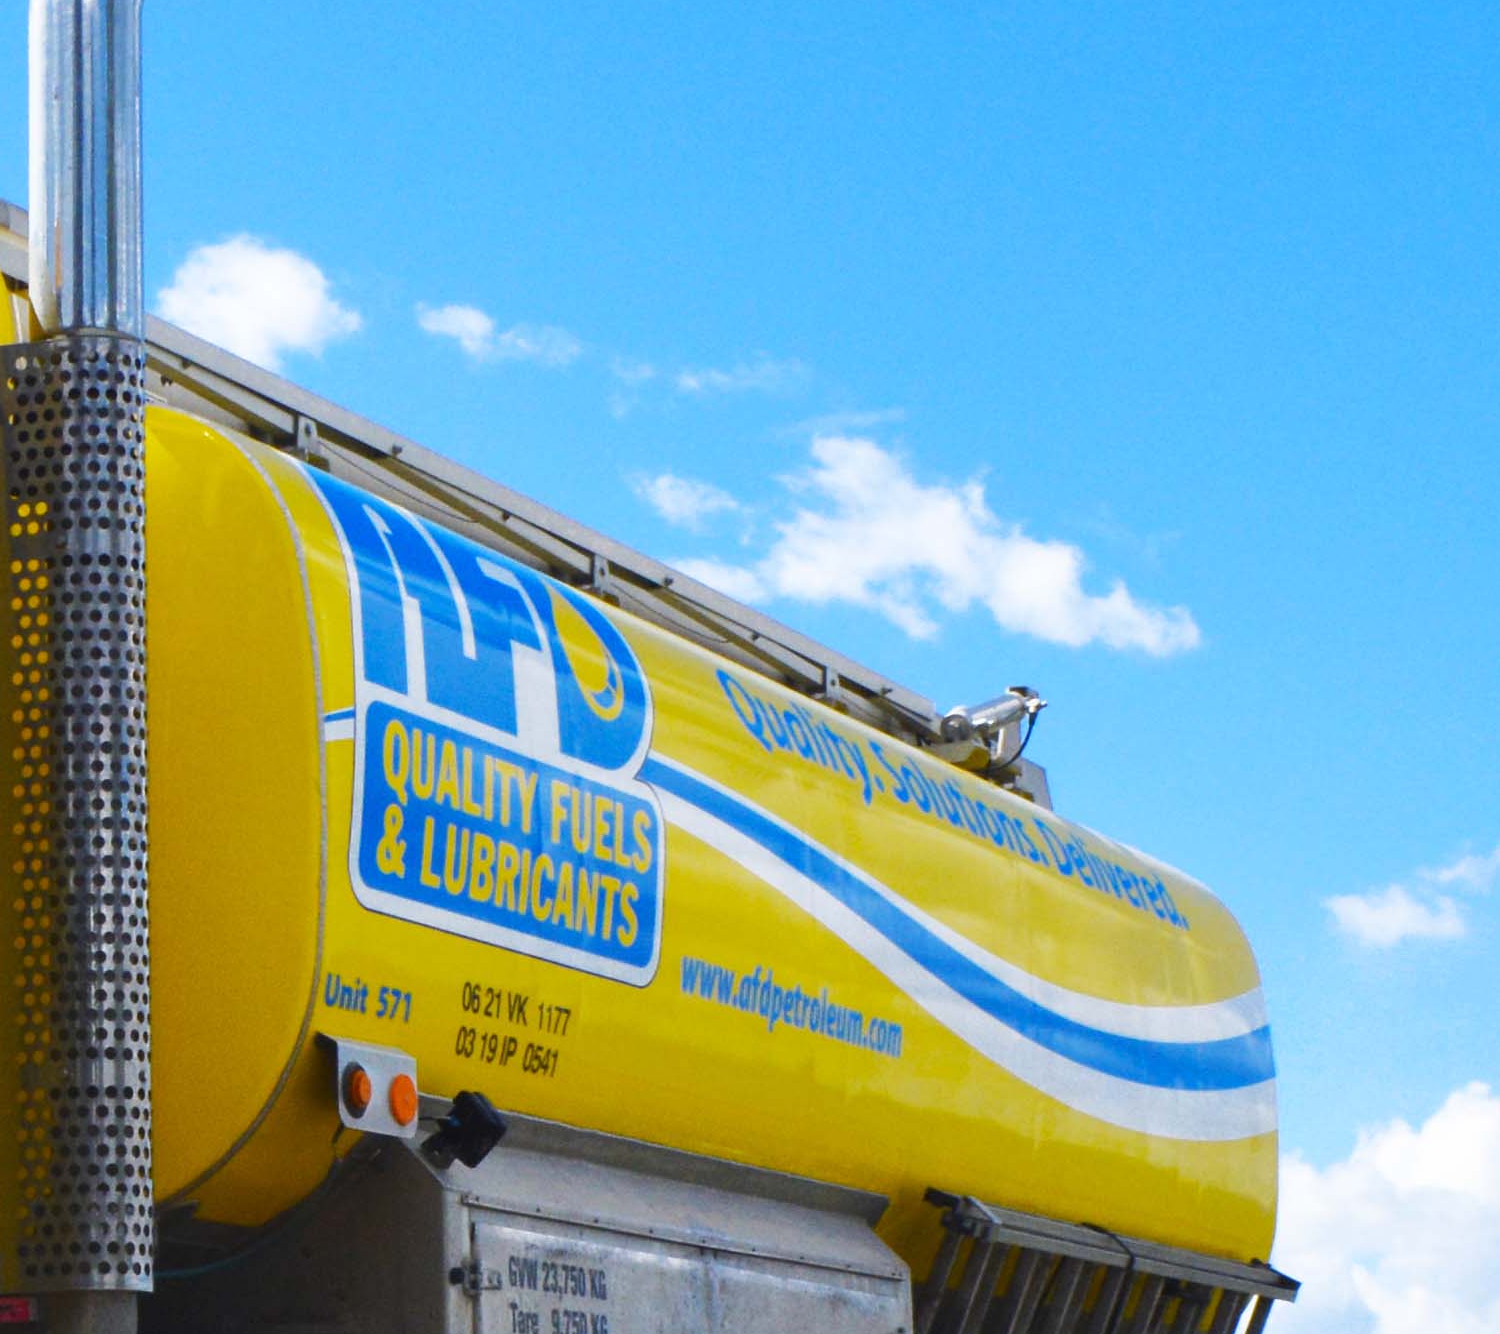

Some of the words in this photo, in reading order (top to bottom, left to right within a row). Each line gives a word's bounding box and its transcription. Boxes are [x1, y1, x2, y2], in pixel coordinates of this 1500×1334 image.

[382, 719, 538, 835] QUALITY
[551, 779, 653, 874] FUELS
[376, 803, 407, 879] &
[419, 815, 640, 948] LUBRICANTS
[324, 972, 369, 1015] Unit
[376, 985, 413, 1024] 571
[461, 981, 481, 1014] 06
[483, 986, 502, 1020] 21
[507, 991, 530, 1027] VK
[537, 1002, 572, 1036] 1177
[680, 955, 903, 1059] www.afdpetroleum.com
[455, 1025, 477, 1059] 03
[480, 1031, 499, 1065] 19
[499, 1034, 518, 1067] IP
[522, 1042, 560, 1078] 0541
[508, 1255, 538, 1292] GVW
[541, 1260, 587, 1302] 23,750
[588, 1268, 608, 1301] KG
